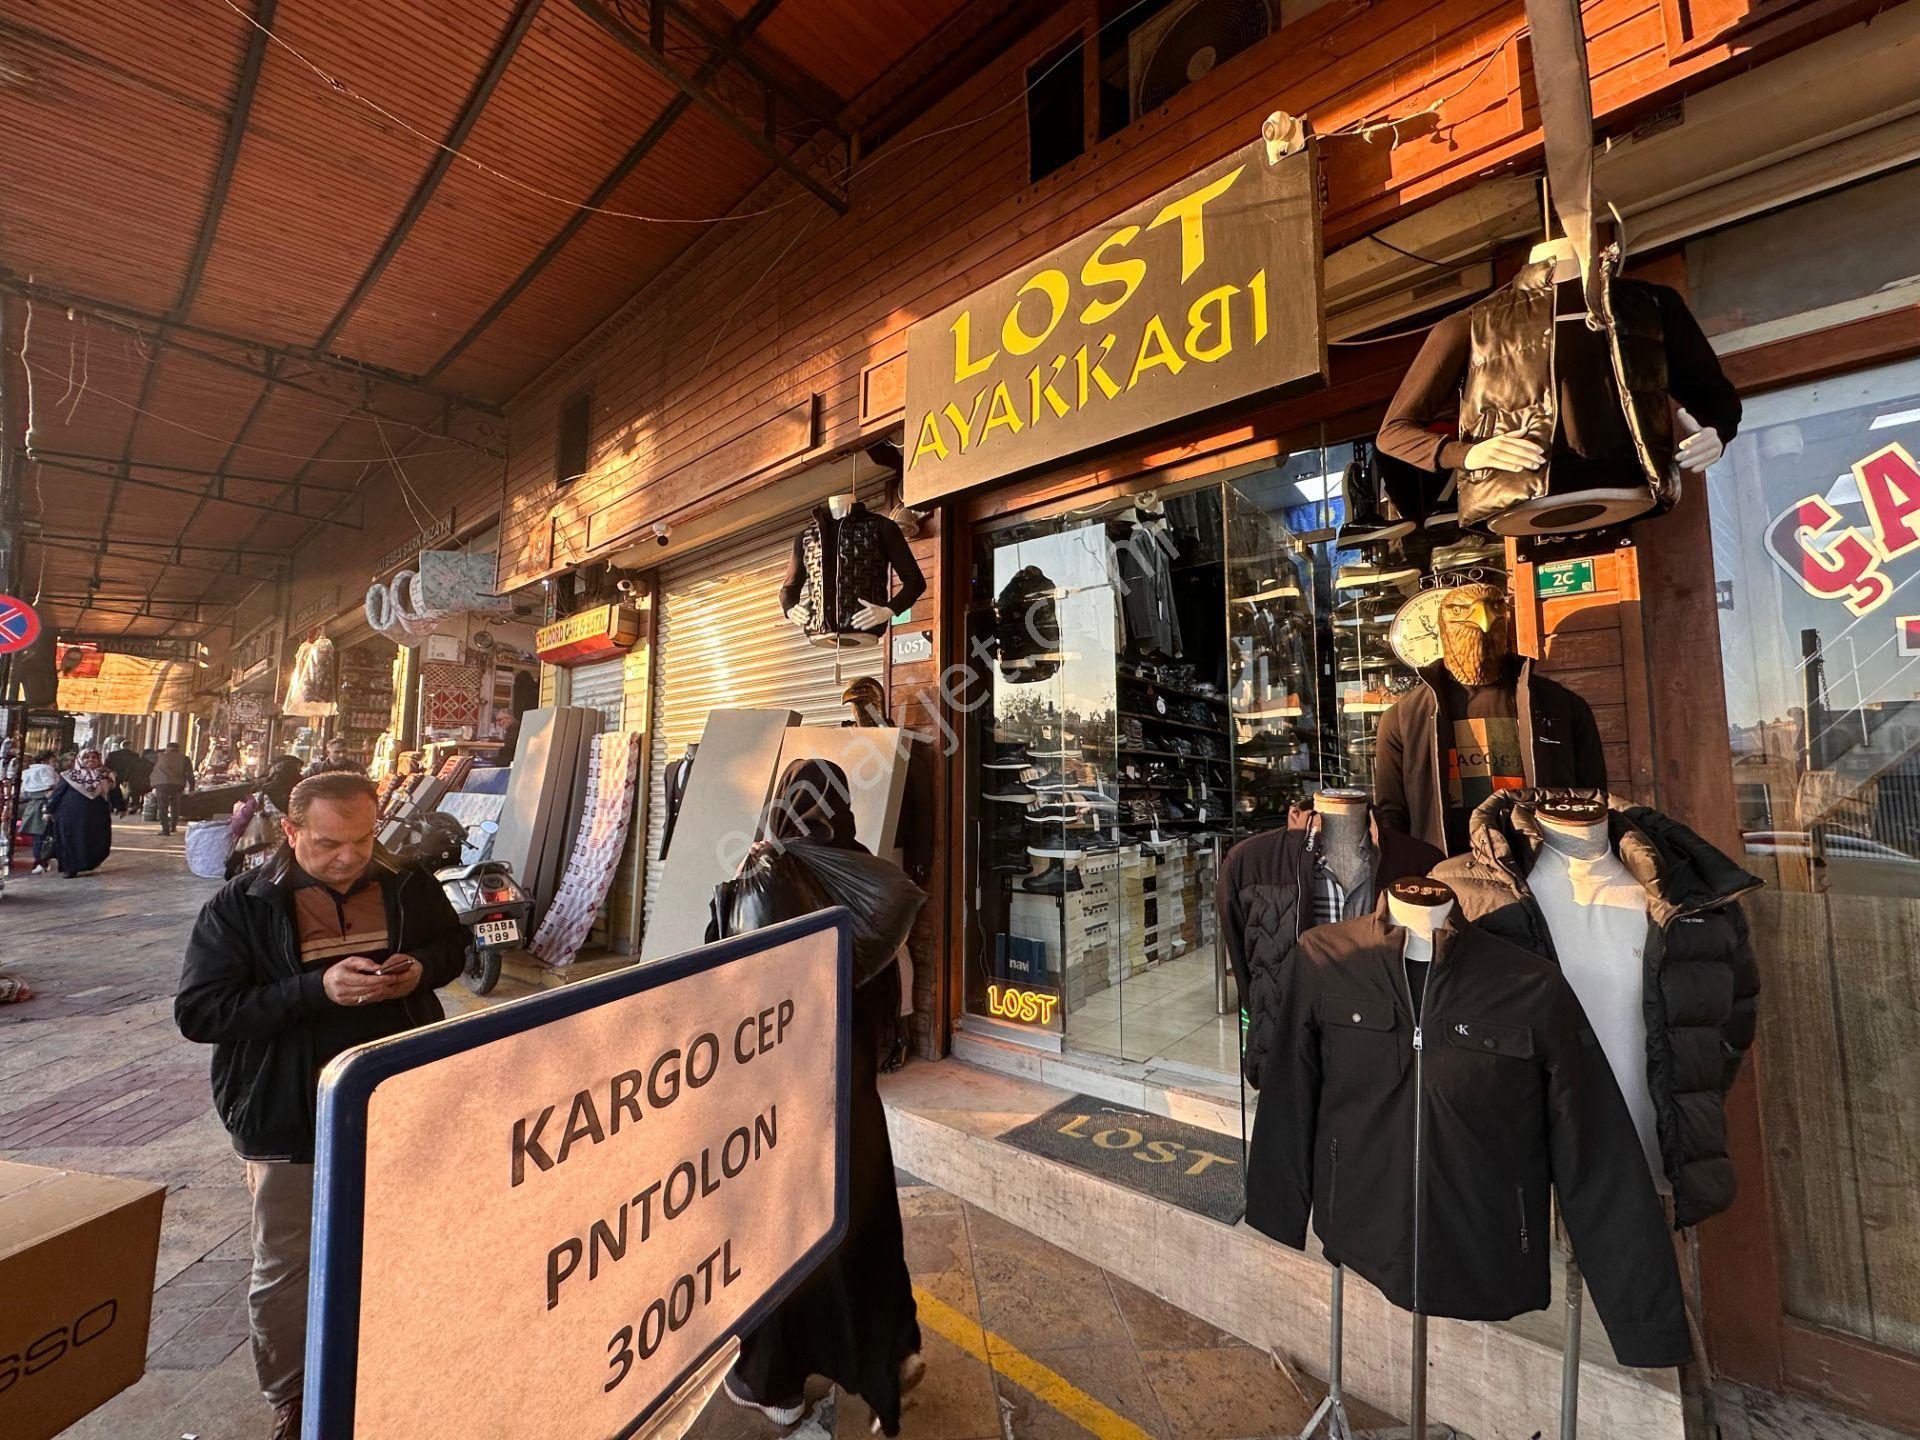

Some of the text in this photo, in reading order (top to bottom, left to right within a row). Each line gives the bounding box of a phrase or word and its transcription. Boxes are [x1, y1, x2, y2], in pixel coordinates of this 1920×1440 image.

[949, 163, 1246, 385] LOST
[908, 268, 1268, 471] AYAKKABI
[1552, 571, 1575, 587] 2C
[898, 639, 925, 656] LOST
[1544, 803, 1599, 812] LOST
[1395, 883, 1447, 897] LOST
[479, 920, 514, 933] 63ABA
[489, 931, 509, 943] 189
[1009, 958, 1029, 973] navi
[987, 984, 1058, 1025] LOST
[511, 998, 795, 1188] KARGO CEP
[1057, 1114, 1239, 1176] LOST
[546, 1104, 778, 1311] PNTOLON
[604, 1238, 741, 1394] 300TL
